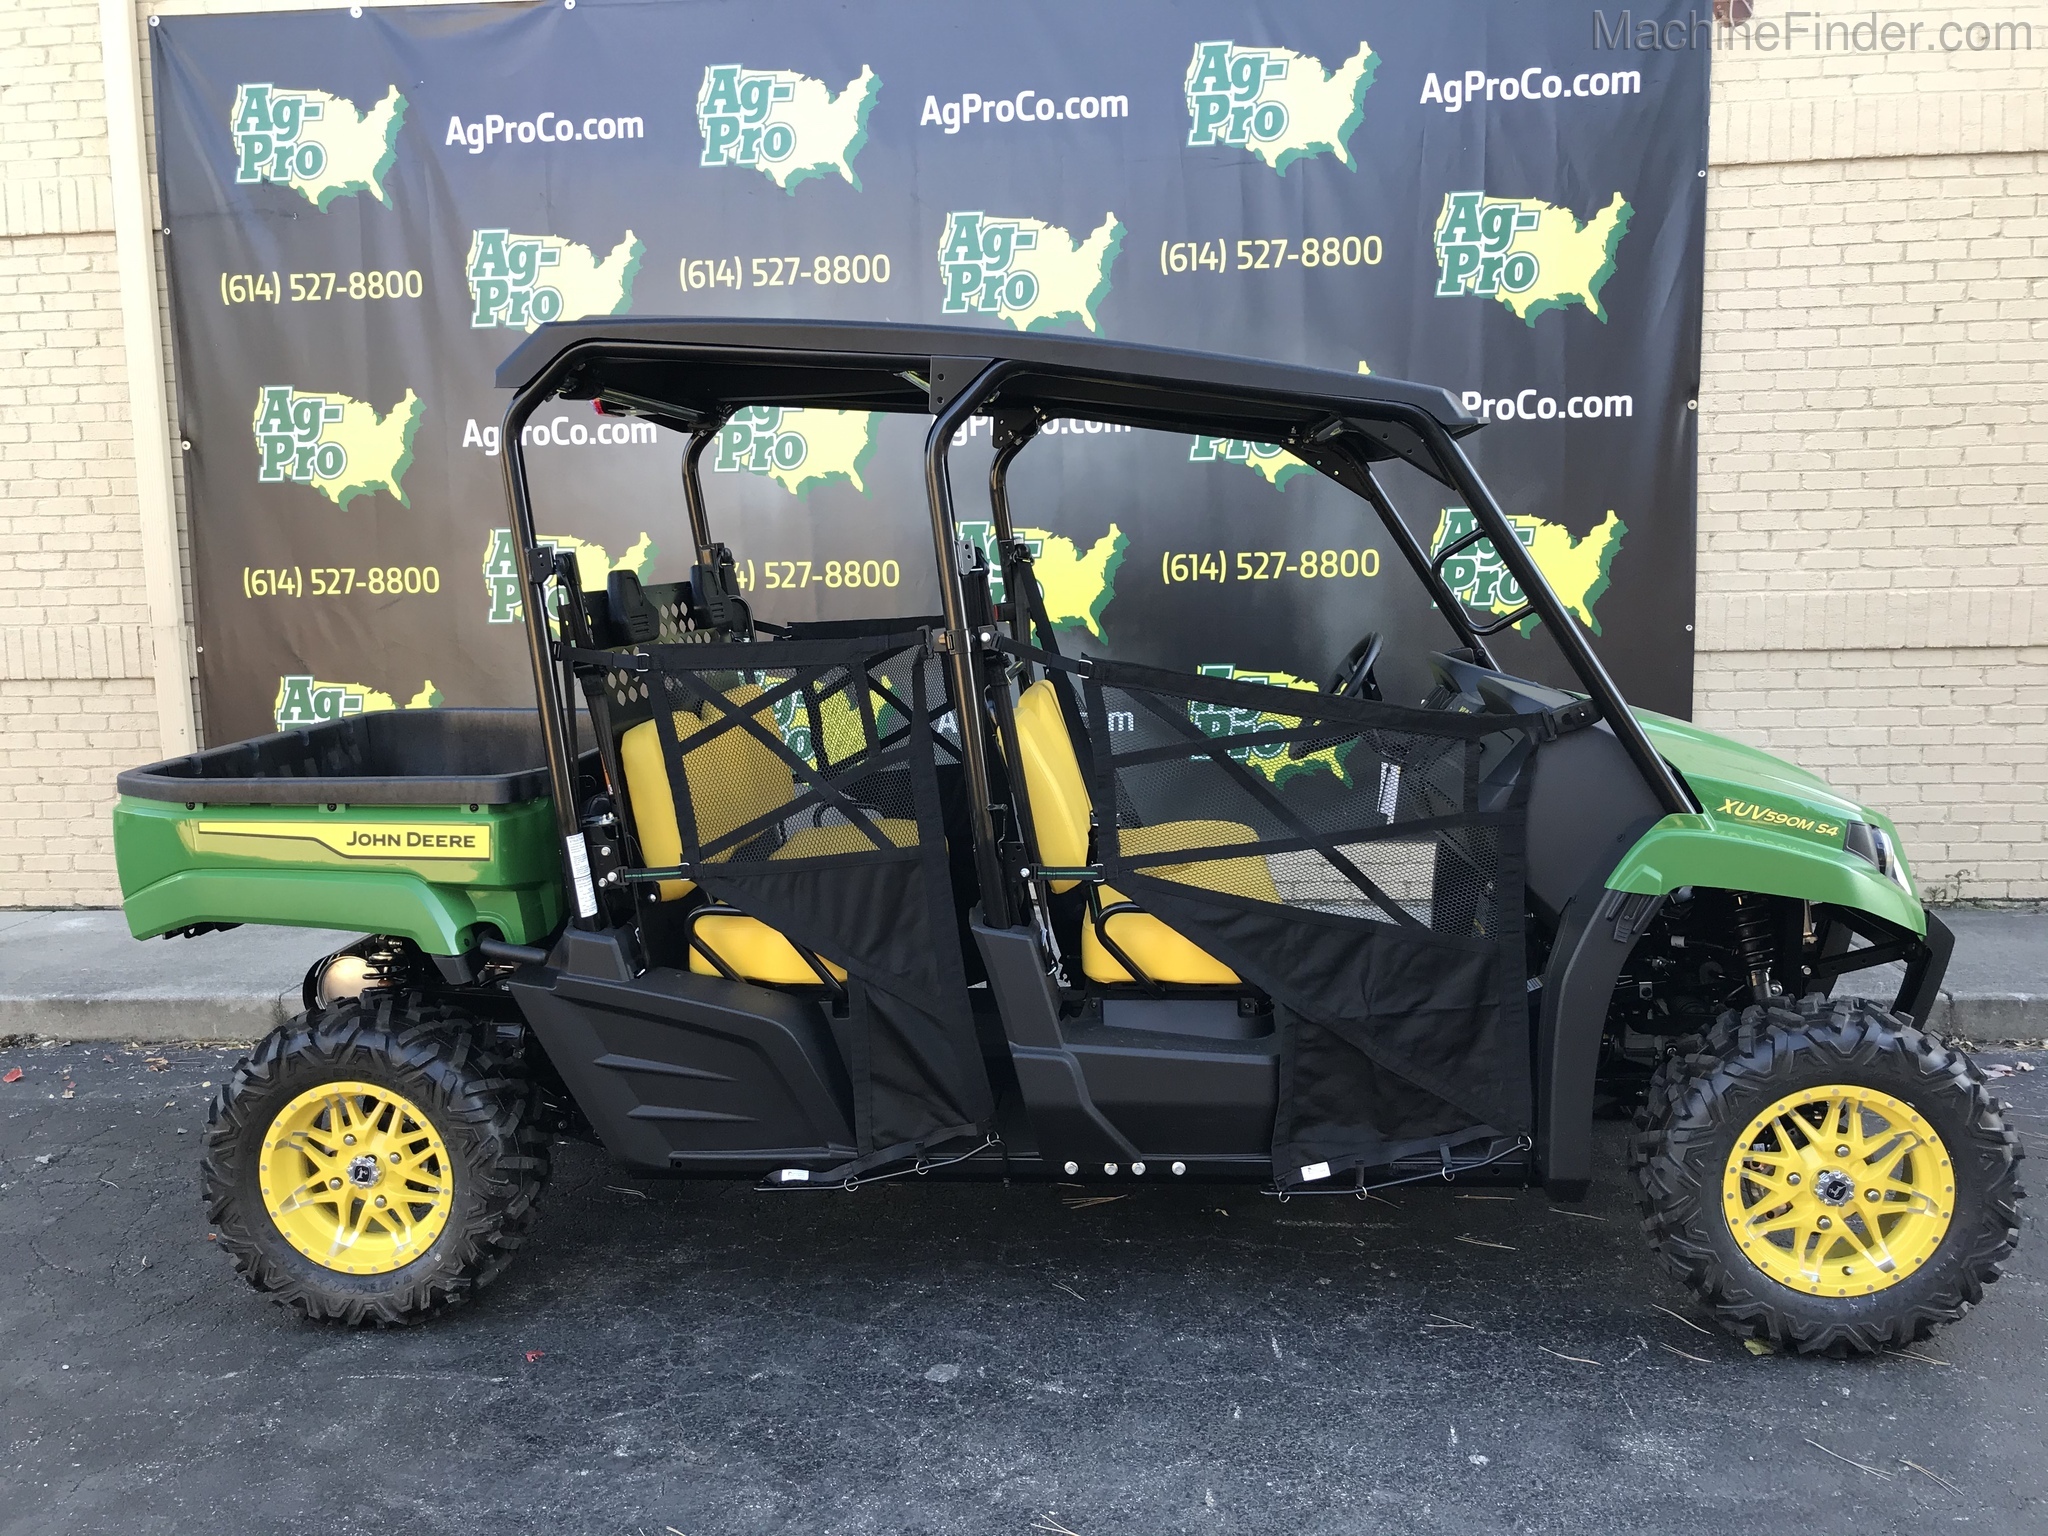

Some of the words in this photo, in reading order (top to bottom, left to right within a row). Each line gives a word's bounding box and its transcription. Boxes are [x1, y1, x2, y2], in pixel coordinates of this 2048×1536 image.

[699, 64, 795, 122] Ag-
[1190, 40, 1289, 102] Ag-
[1420, 68, 1640, 112] AgProCo.com
[236, 83, 325, 141] Ag-
[446, 112, 643, 154] AgProCo.com
[921, 91, 1128, 134] AgProCo.com
[1188, 94, 1289, 146] Pro
[236, 132, 326, 183] Pro
[699, 115, 796, 166] Pro
[941, 212, 1038, 270] Ag-
[1437, 191, 1539, 251] Ag-
[467, 229, 560, 284] Ag-
[681, 257, 741, 291] (614)
[753, 255, 889, 286] 527-8800
[1161, 239, 1226, 275] (614)
[1238, 236, 1382, 269] 527-8800
[1435, 243, 1539, 296] Pro
[222, 272, 280, 305] (614)
[290, 271, 422, 301] 527-8800
[469, 279, 564, 328] Pro
[941, 262, 1039, 313] Pro
[257, 386, 344, 440] Ag-
[1462, 389, 1632, 421] ProCo.com
[258, 434, 347, 482] Pro
[463, 416, 657, 456] AgroCo.com
[714, 424, 807, 472] Pro
[244, 567, 302, 598] (614)
[311, 566, 439, 594] 527-8800
[765, 559, 900, 589] 527-8800
[1163, 550, 1226, 584] (614)
[1238, 549, 1379, 579] 527-8800
[347, 831, 401, 847] JOHN
[407, 832, 475, 848] DEERE
[1717, 798, 1814, 831] XUV590M
[1815, 822, 1841, 837] S4
